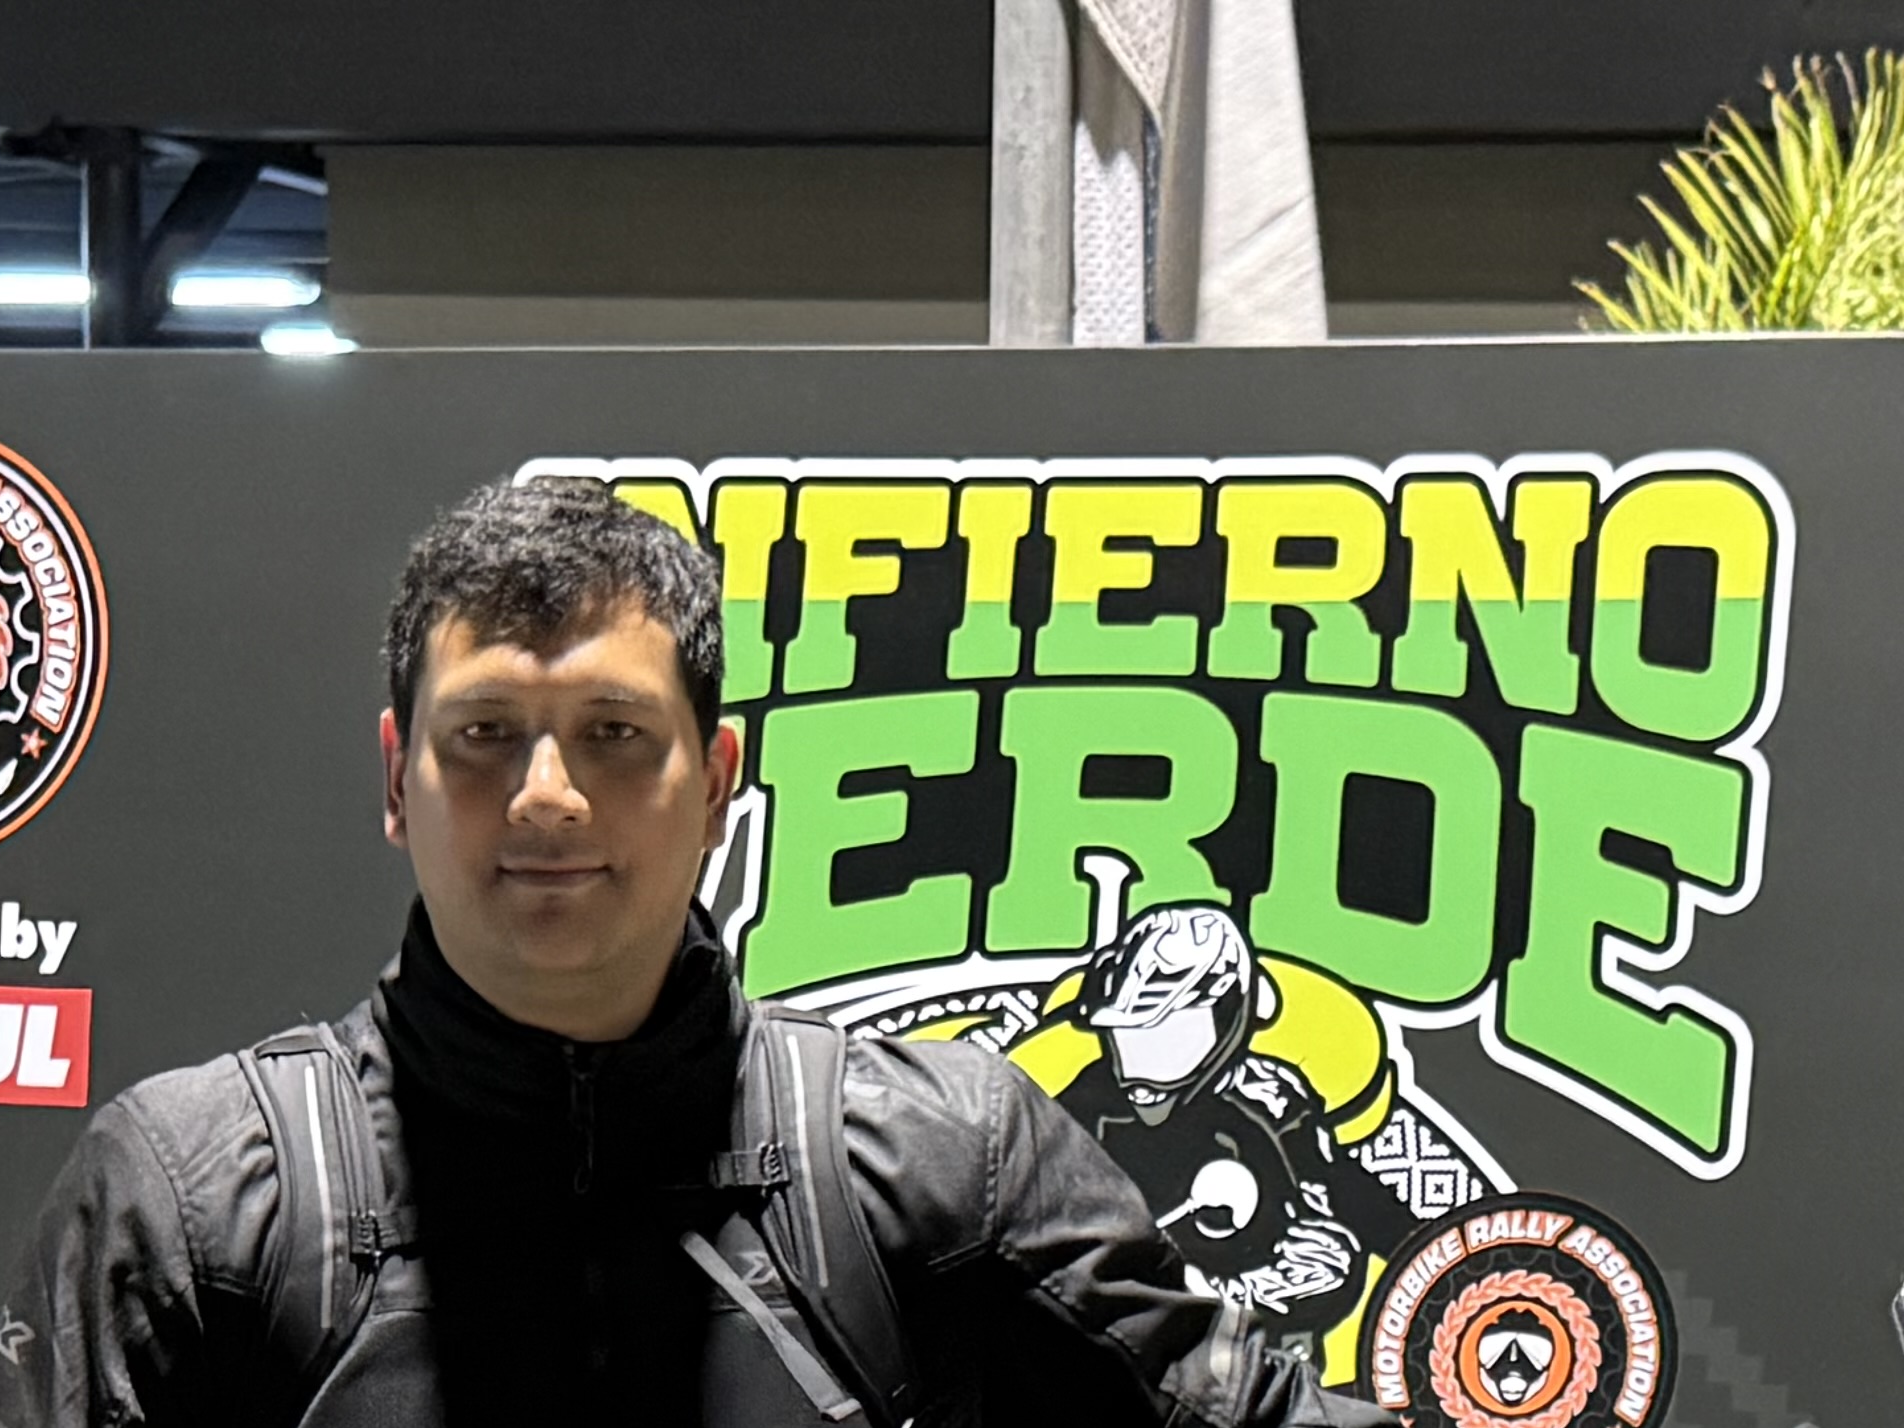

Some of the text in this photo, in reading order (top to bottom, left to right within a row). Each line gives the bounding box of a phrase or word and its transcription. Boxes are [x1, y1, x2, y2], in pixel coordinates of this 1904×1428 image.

[610, 476, 1773, 744] NFIERNO
[0, 902, 77, 974] by
[726, 686, 1749, 1156] ERDE
[1376, 1212, 1658, 1423] MOTORBIKE RALLY ASSOCIATION
